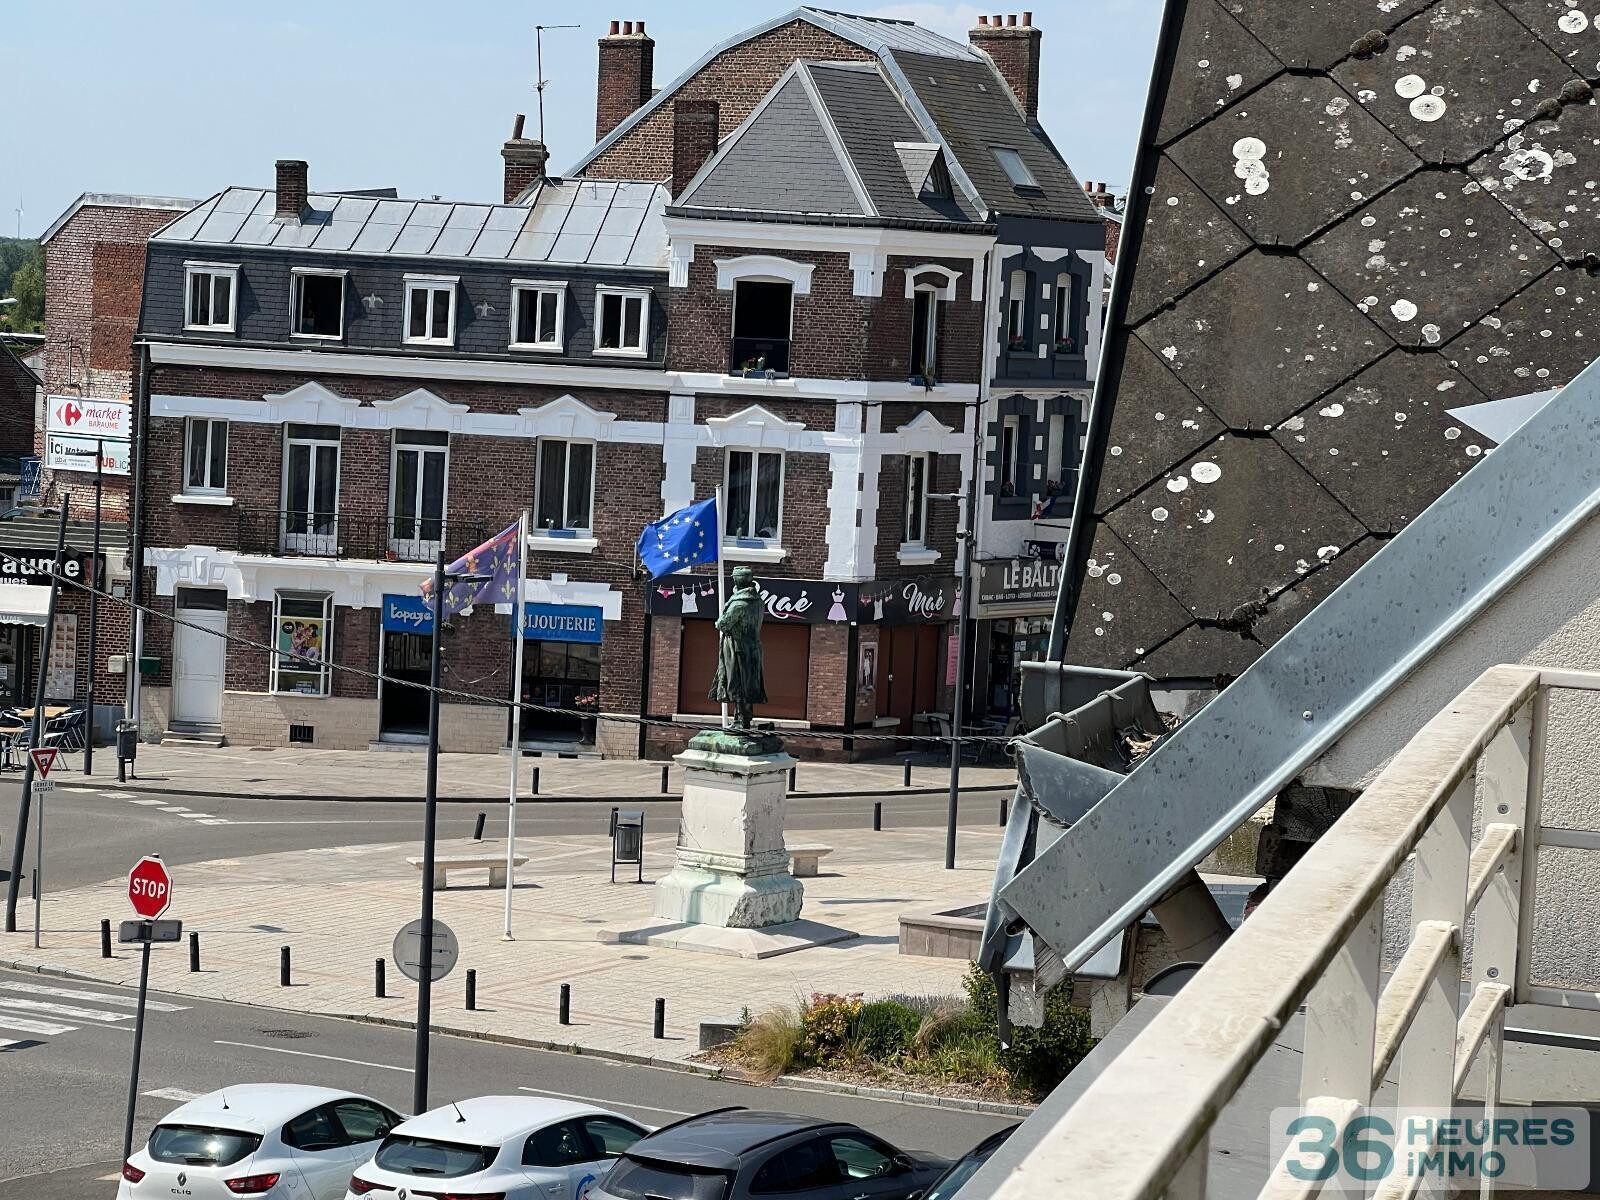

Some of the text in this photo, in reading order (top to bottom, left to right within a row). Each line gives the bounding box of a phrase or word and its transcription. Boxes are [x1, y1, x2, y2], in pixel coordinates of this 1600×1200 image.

[86, 407, 123, 421] market
[2, 557, 80, 577] aume
[1003, 567, 1020, 589] LE
[903, 583, 945, 618] Maé
[132, 877, 166, 899] STOP
[171, 1188, 192, 1196] CLIO
